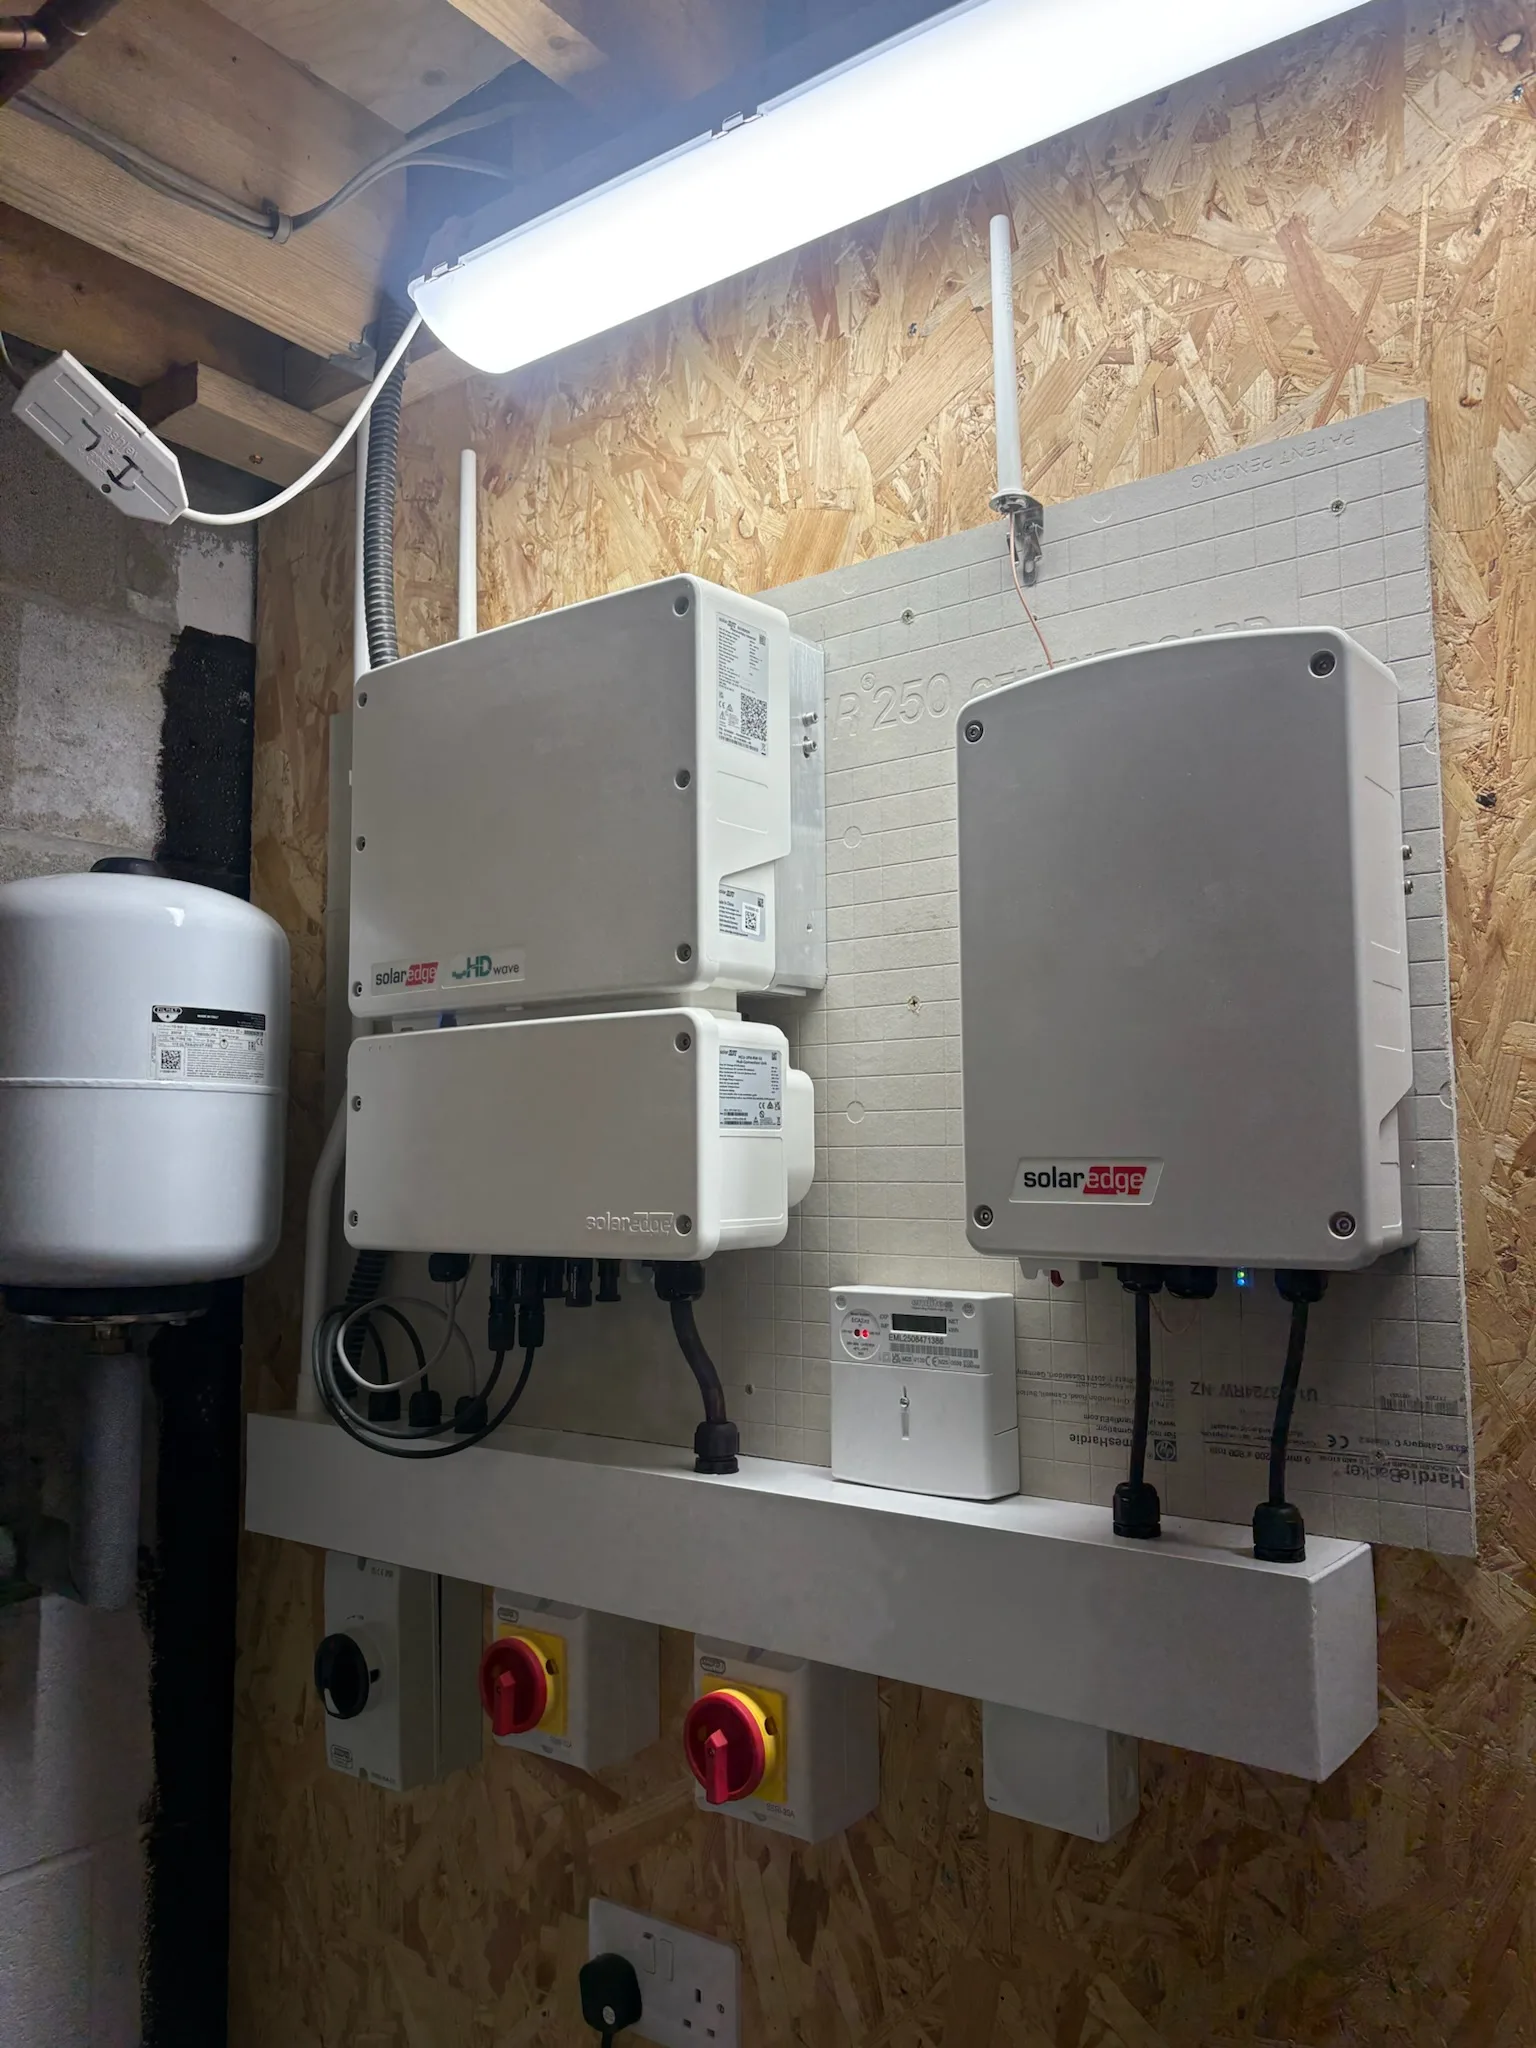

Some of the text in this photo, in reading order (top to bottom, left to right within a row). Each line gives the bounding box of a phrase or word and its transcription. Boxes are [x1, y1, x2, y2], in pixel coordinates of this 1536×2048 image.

[1191, 428, 1357, 490] PATENT PENDING
[375, 961, 439, 987] solaredge
[493, 962, 520, 976] wave
[1024, 1165, 1146, 1197] solaredge
[585, 1211, 674, 1237] solaredge
[1344, 1464, 1465, 1490] HardieBacker
